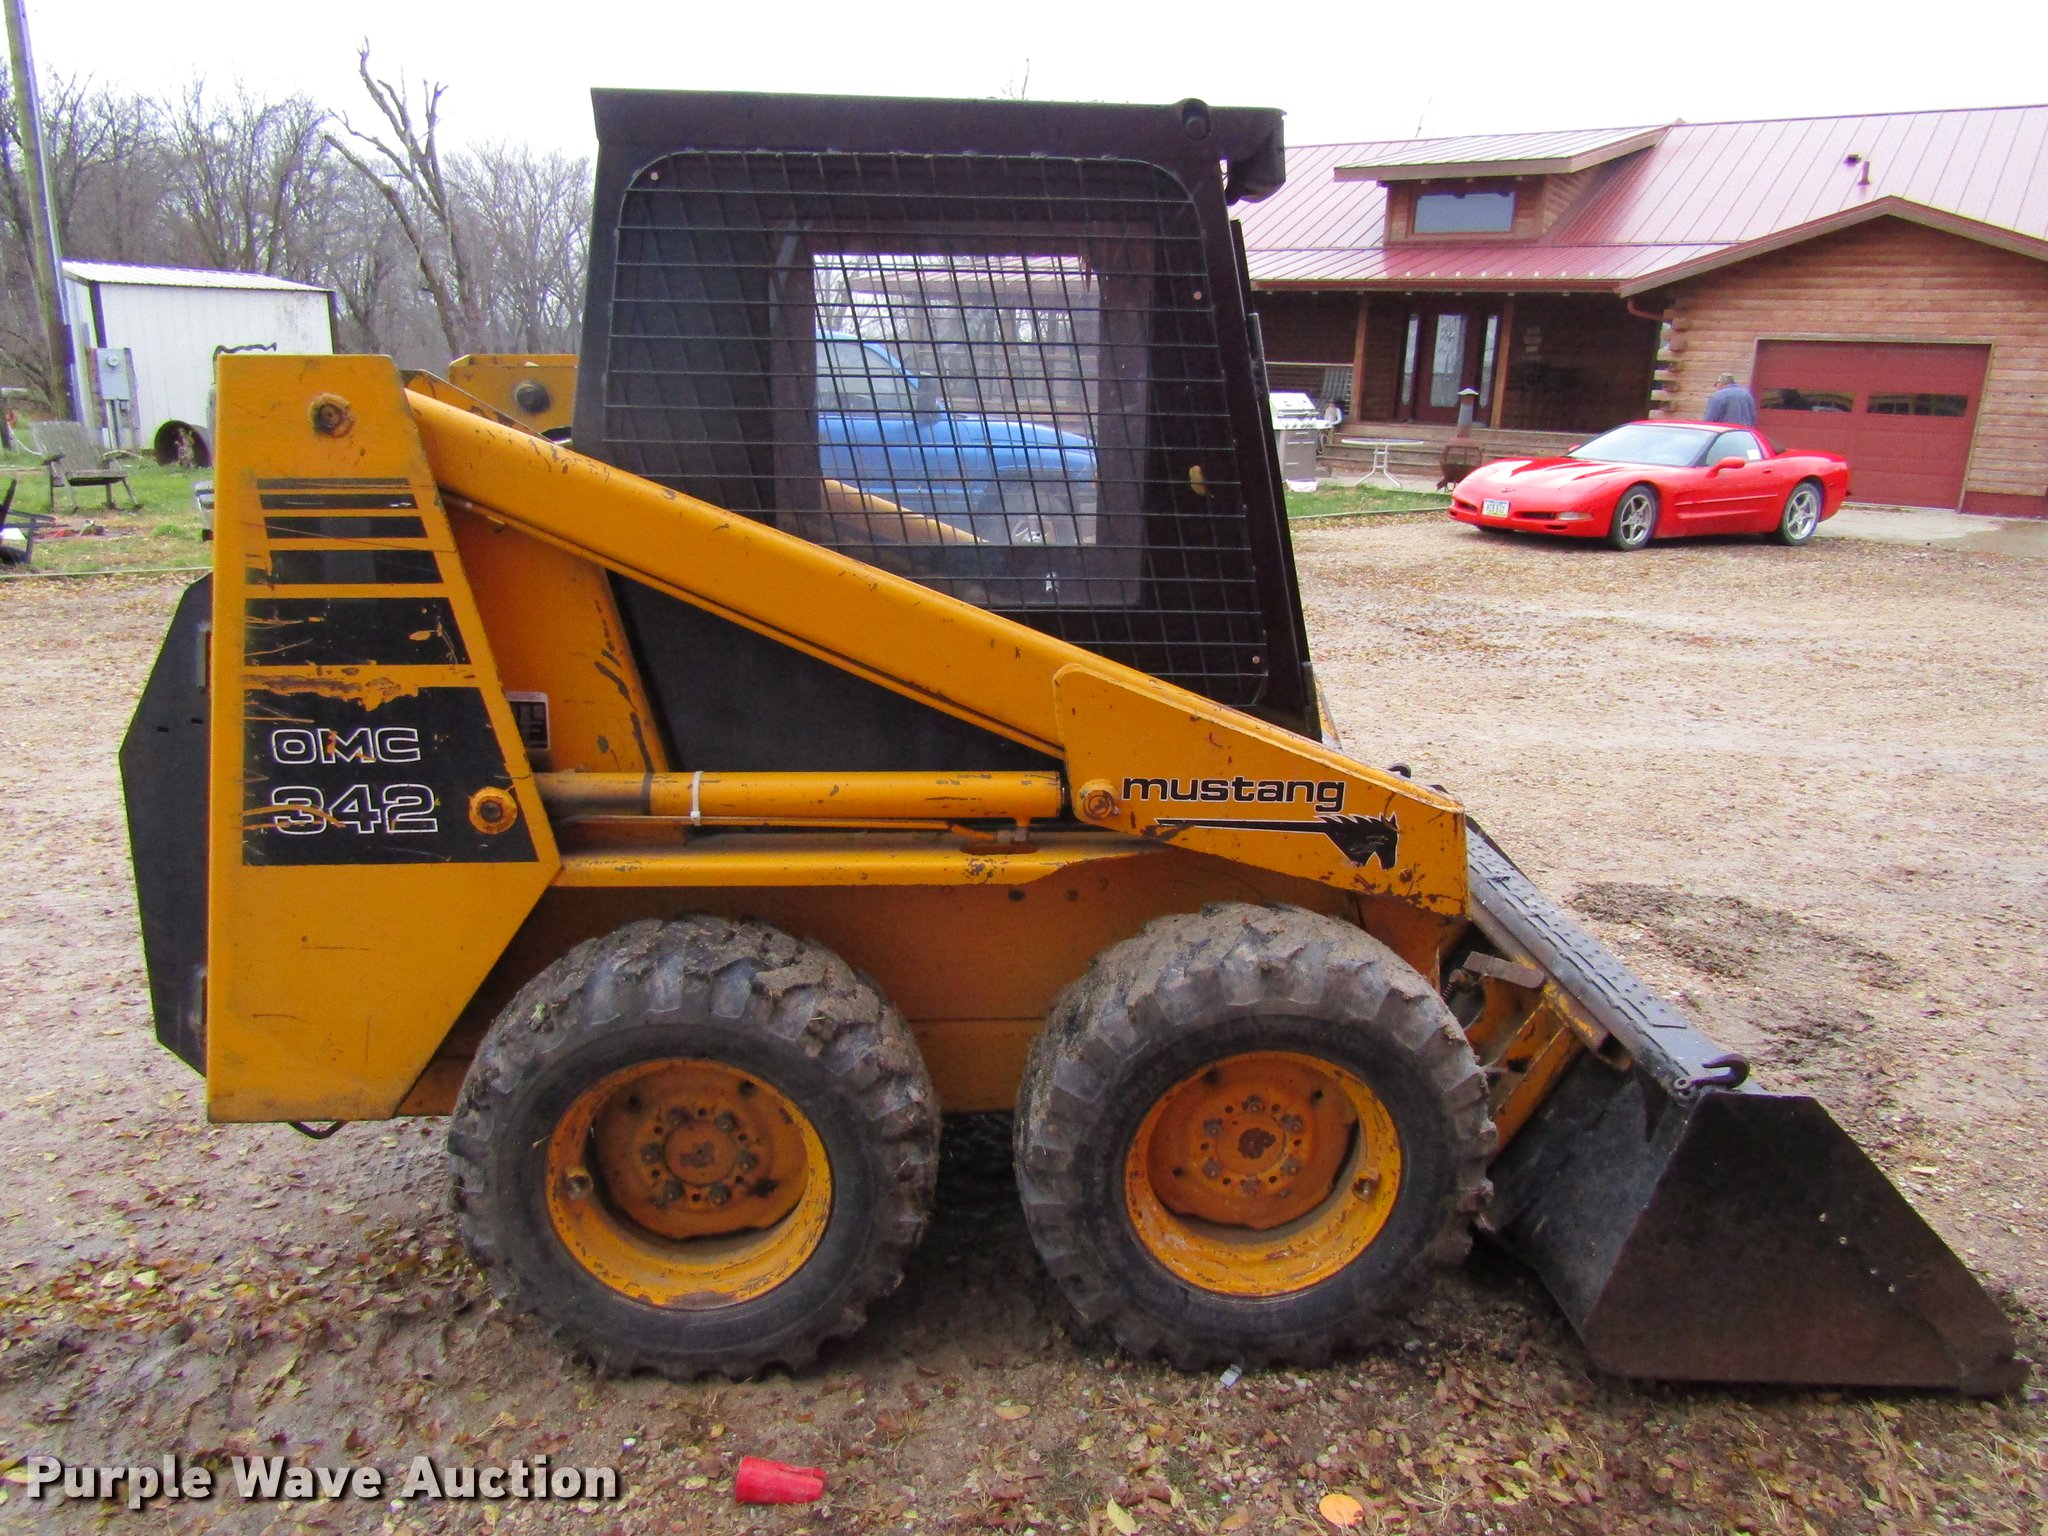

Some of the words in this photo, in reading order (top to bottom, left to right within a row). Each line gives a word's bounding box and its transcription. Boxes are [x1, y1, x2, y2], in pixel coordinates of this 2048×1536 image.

[272, 727, 421, 765] OMC
[272, 783, 439, 835] 342
[1122, 775, 1345, 812] mustang
